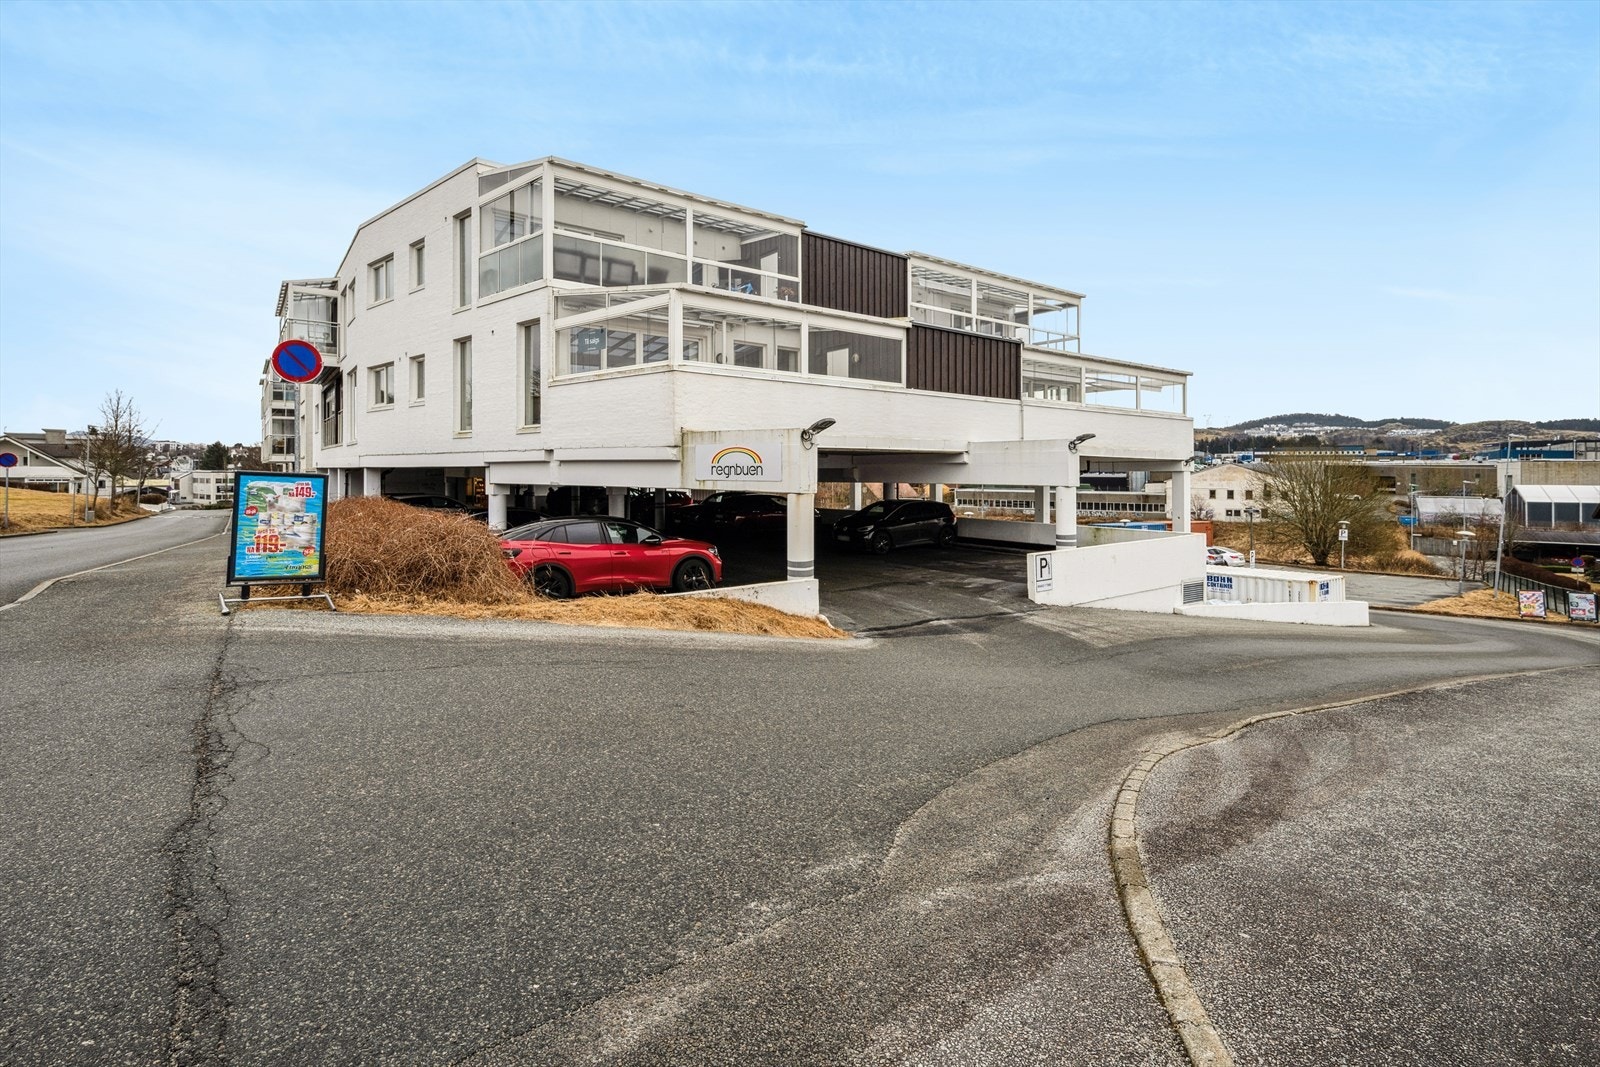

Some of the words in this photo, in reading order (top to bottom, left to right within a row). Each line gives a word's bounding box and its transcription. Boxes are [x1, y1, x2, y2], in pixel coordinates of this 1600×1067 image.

[711, 464, 763, 478] regnbuen
[1040, 557, 1047, 578] P
[1206, 575, 1233, 584] BOHN
